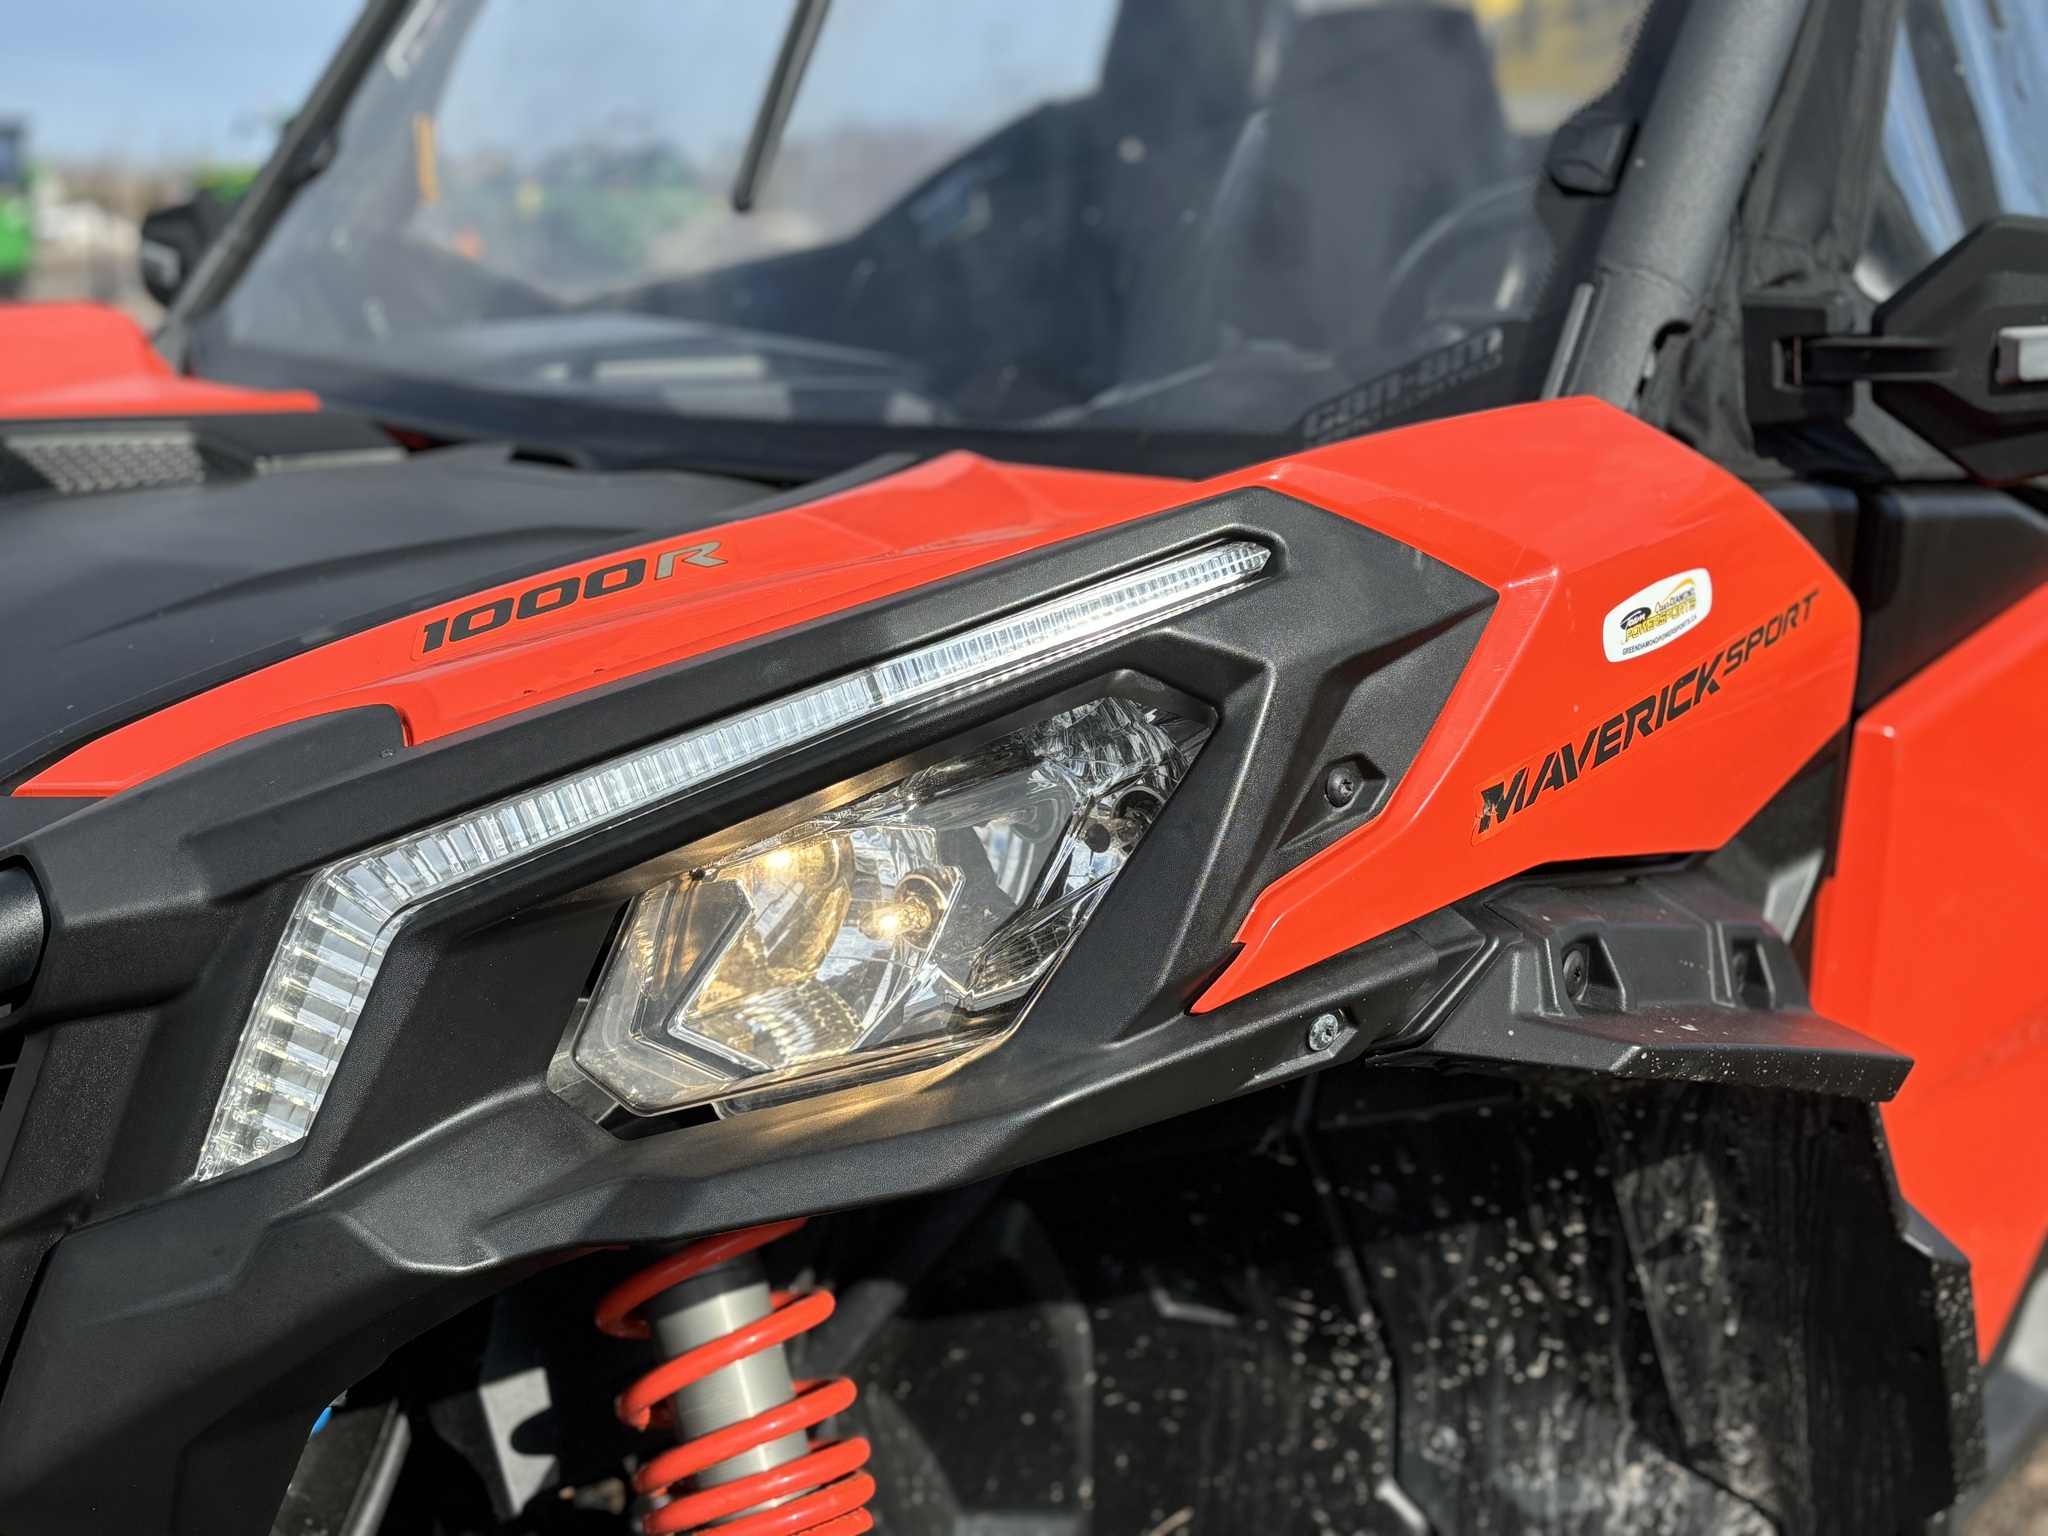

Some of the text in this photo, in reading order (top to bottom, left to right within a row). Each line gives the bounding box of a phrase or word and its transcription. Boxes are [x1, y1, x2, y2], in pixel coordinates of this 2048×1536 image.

[1621, 614, 1698, 656] GREENDIAMONDPOWERSPORTS.CA
[1626, 596, 1697, 642] POWERSPORTS
[1477, 589, 1821, 835] MAVERICK SPORT
